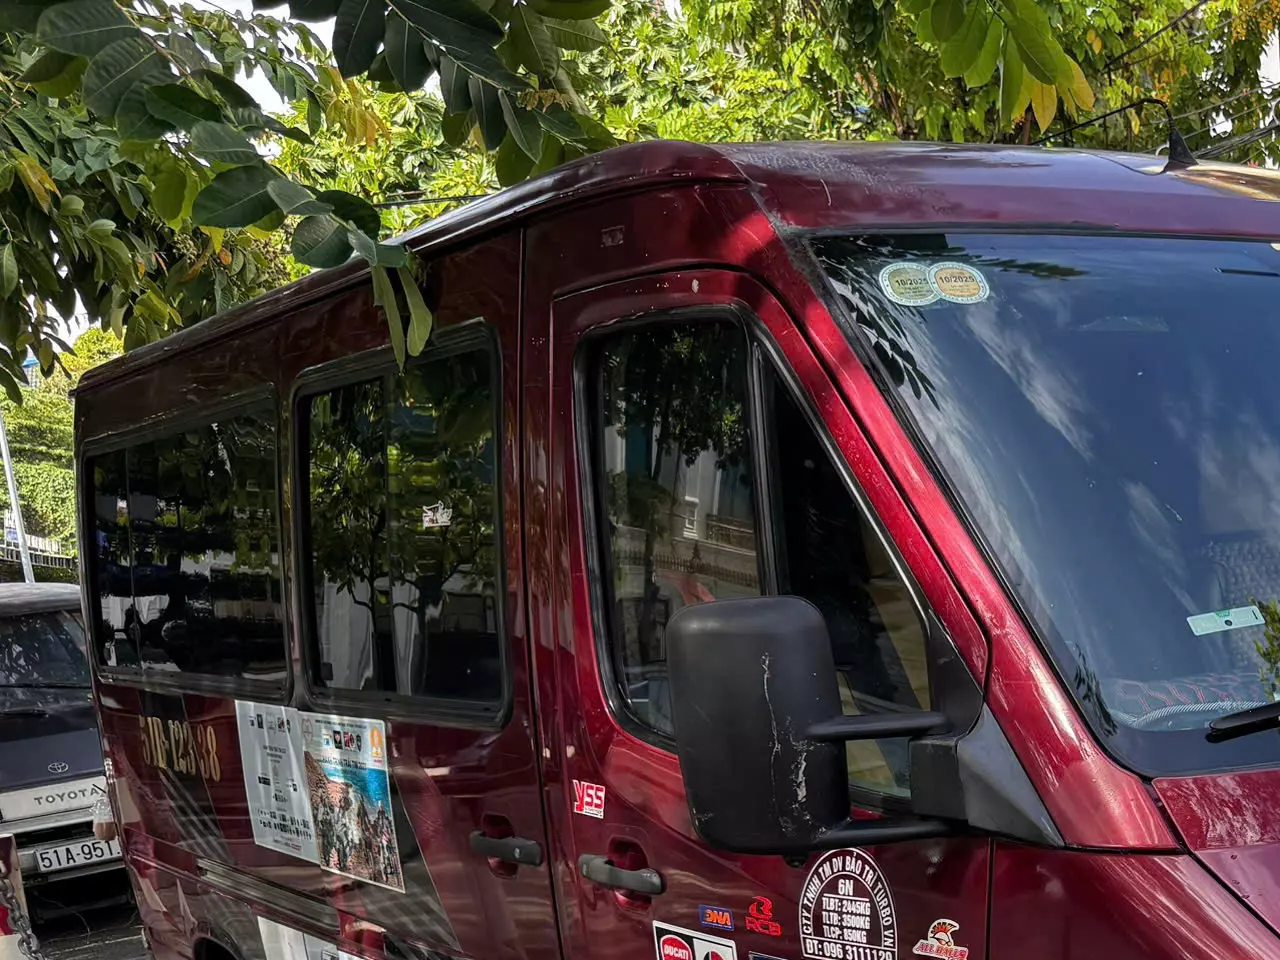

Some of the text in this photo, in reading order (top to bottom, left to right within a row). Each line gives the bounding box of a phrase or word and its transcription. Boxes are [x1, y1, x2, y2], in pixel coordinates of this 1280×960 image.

[34, 788, 101, 806] TOYOTA
[818, 860, 832, 881] TM
[832, 856, 843, 872] DV
[845, 852, 862, 875] BẢO
[803, 874, 822, 908] TNHH
[838, 879, 853, 896] 6N
[874, 882, 893, 926] TURBO
[745, 915, 782, 937] RCB
[802, 909, 813, 934] CTY
[883, 929, 894, 947] VN
[664, 944, 689, 960] DUCATI
[823, 943, 843, 959] 096
